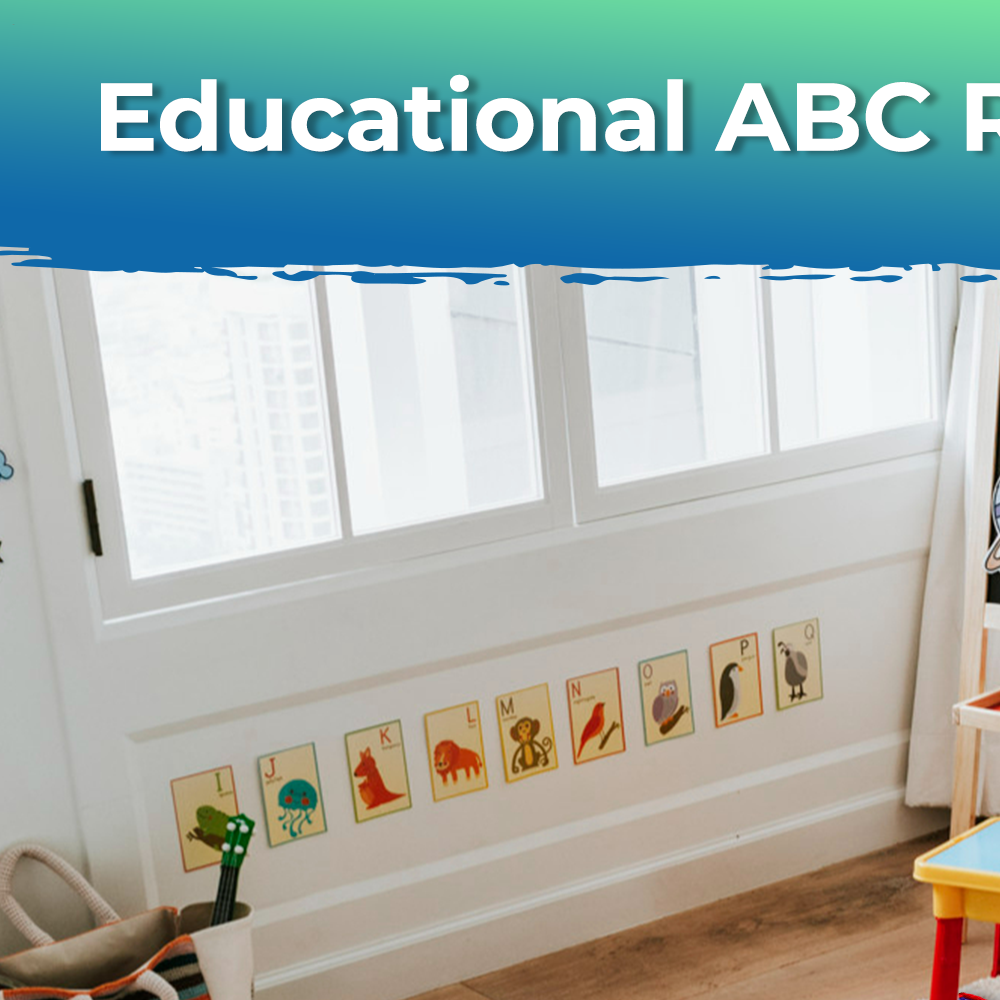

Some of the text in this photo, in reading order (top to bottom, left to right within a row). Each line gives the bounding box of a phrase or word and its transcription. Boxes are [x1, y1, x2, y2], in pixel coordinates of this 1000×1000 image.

[804, 623, 815, 640] Q
[740, 639, 749, 656] P
[643, 663, 653, 680] O
[571, 680, 582, 699] N
[466, 706, 476, 723] L
[500, 697, 514, 717] M
[379, 726, 391, 745] K
[264, 757, 276, 779] J
[215, 772, 222, 792] I
